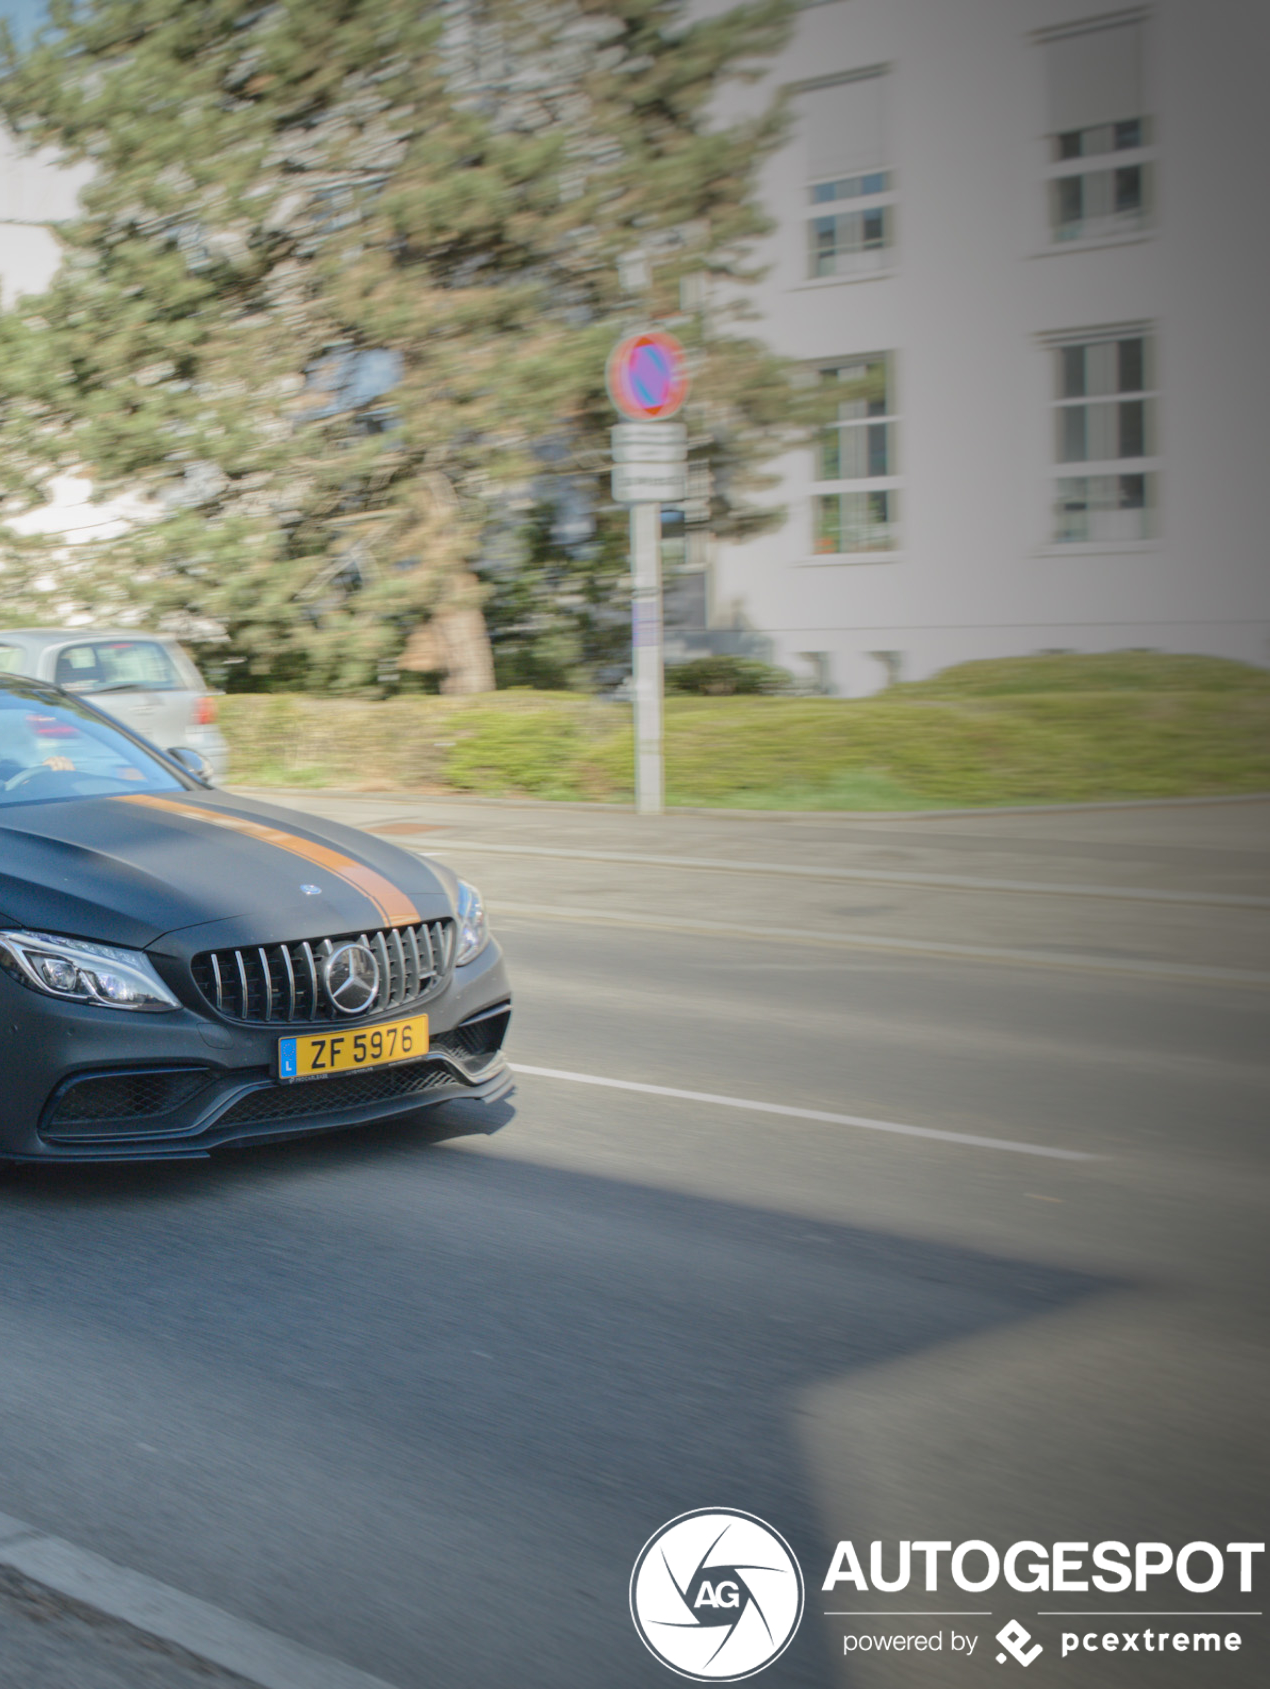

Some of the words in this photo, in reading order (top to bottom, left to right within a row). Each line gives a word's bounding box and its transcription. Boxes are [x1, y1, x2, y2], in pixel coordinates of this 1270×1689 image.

[311, 1037, 345, 1069] ZF
[353, 1025, 413, 1063] 5976
[285, 1060, 292, 1072] L
